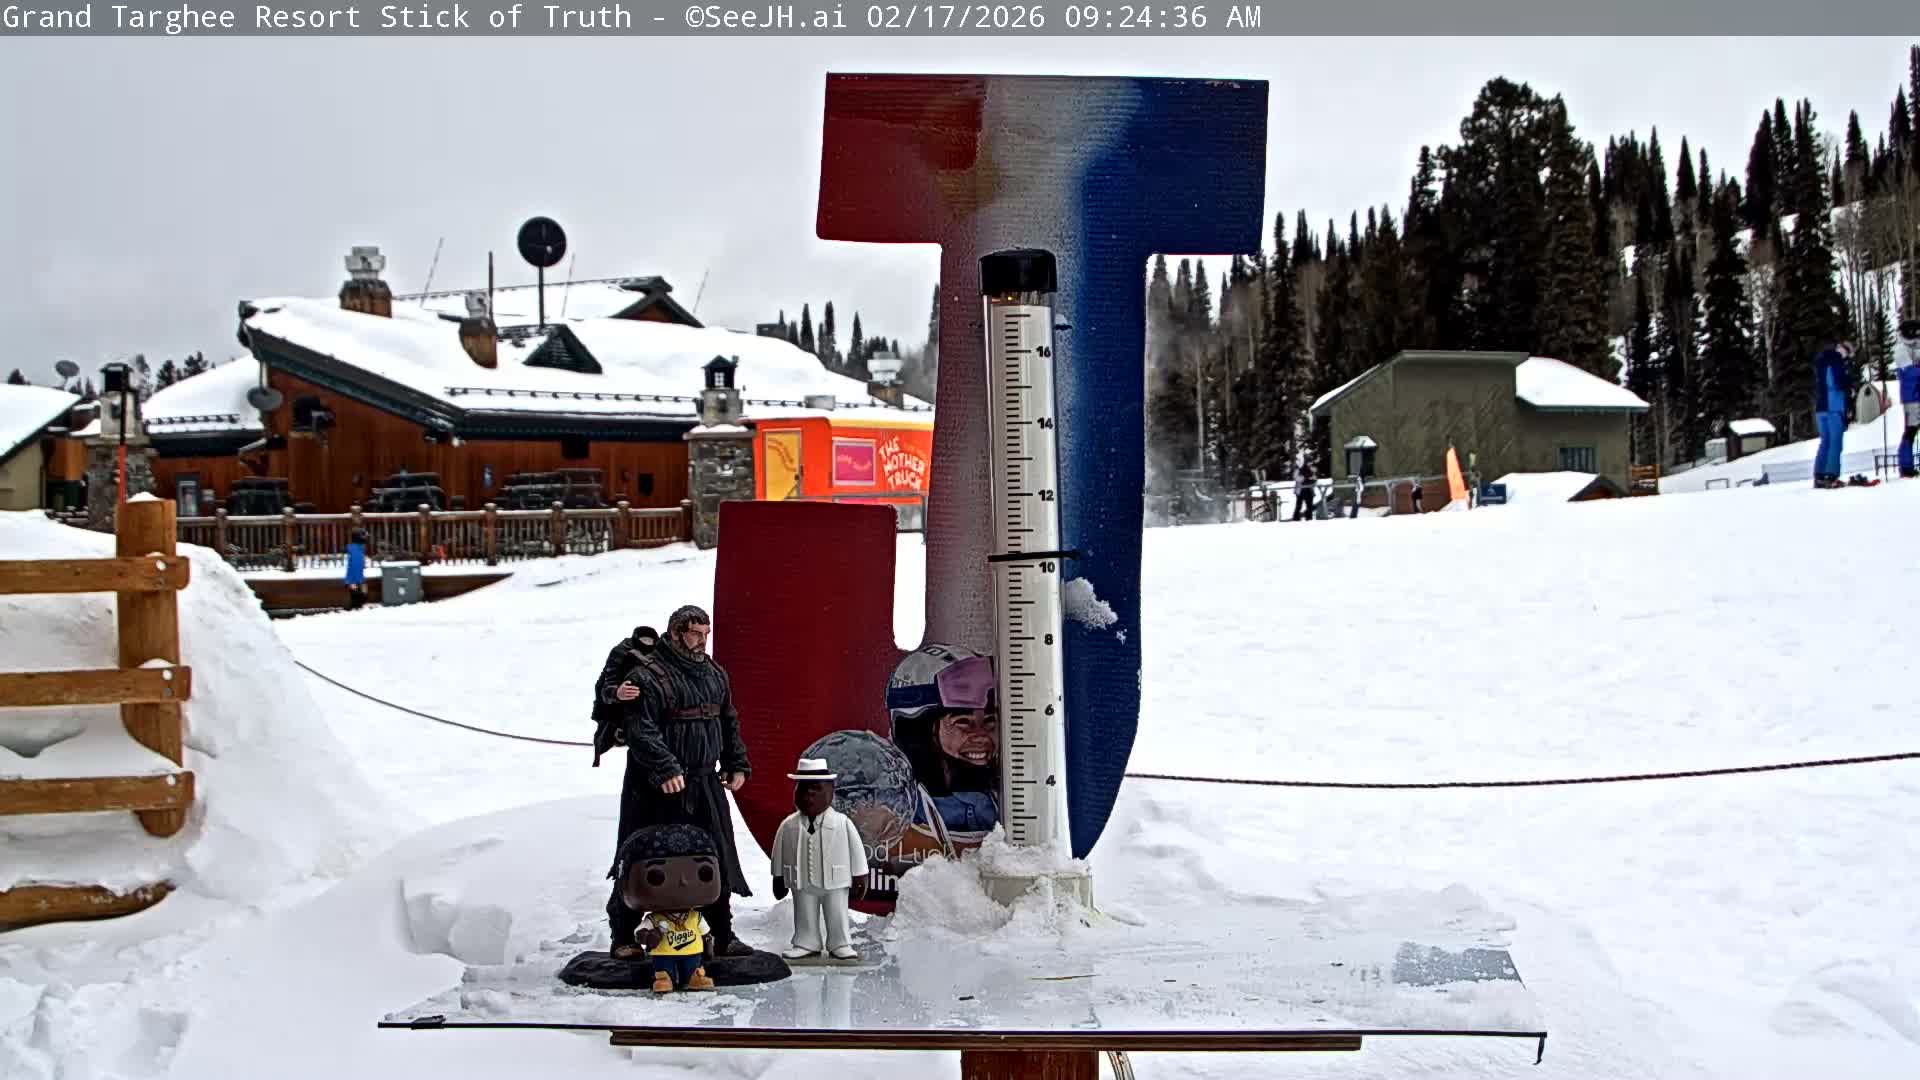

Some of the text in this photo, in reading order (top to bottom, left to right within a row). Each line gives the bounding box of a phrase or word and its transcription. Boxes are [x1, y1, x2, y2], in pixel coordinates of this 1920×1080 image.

[1036, 346, 1051, 358] 16
[1037, 417, 1053, 430] 14
[878, 435, 900, 461] THE
[883, 453, 925, 477] MOTHER
[887, 469, 922, 491] TRUCK
[1038, 489, 1054, 501] 12
[1038, 561, 1055, 574] 10
[1044, 633, 1054, 646] 8
[1044, 704, 1055, 716] 6
[1045, 775, 1056, 787] 4
